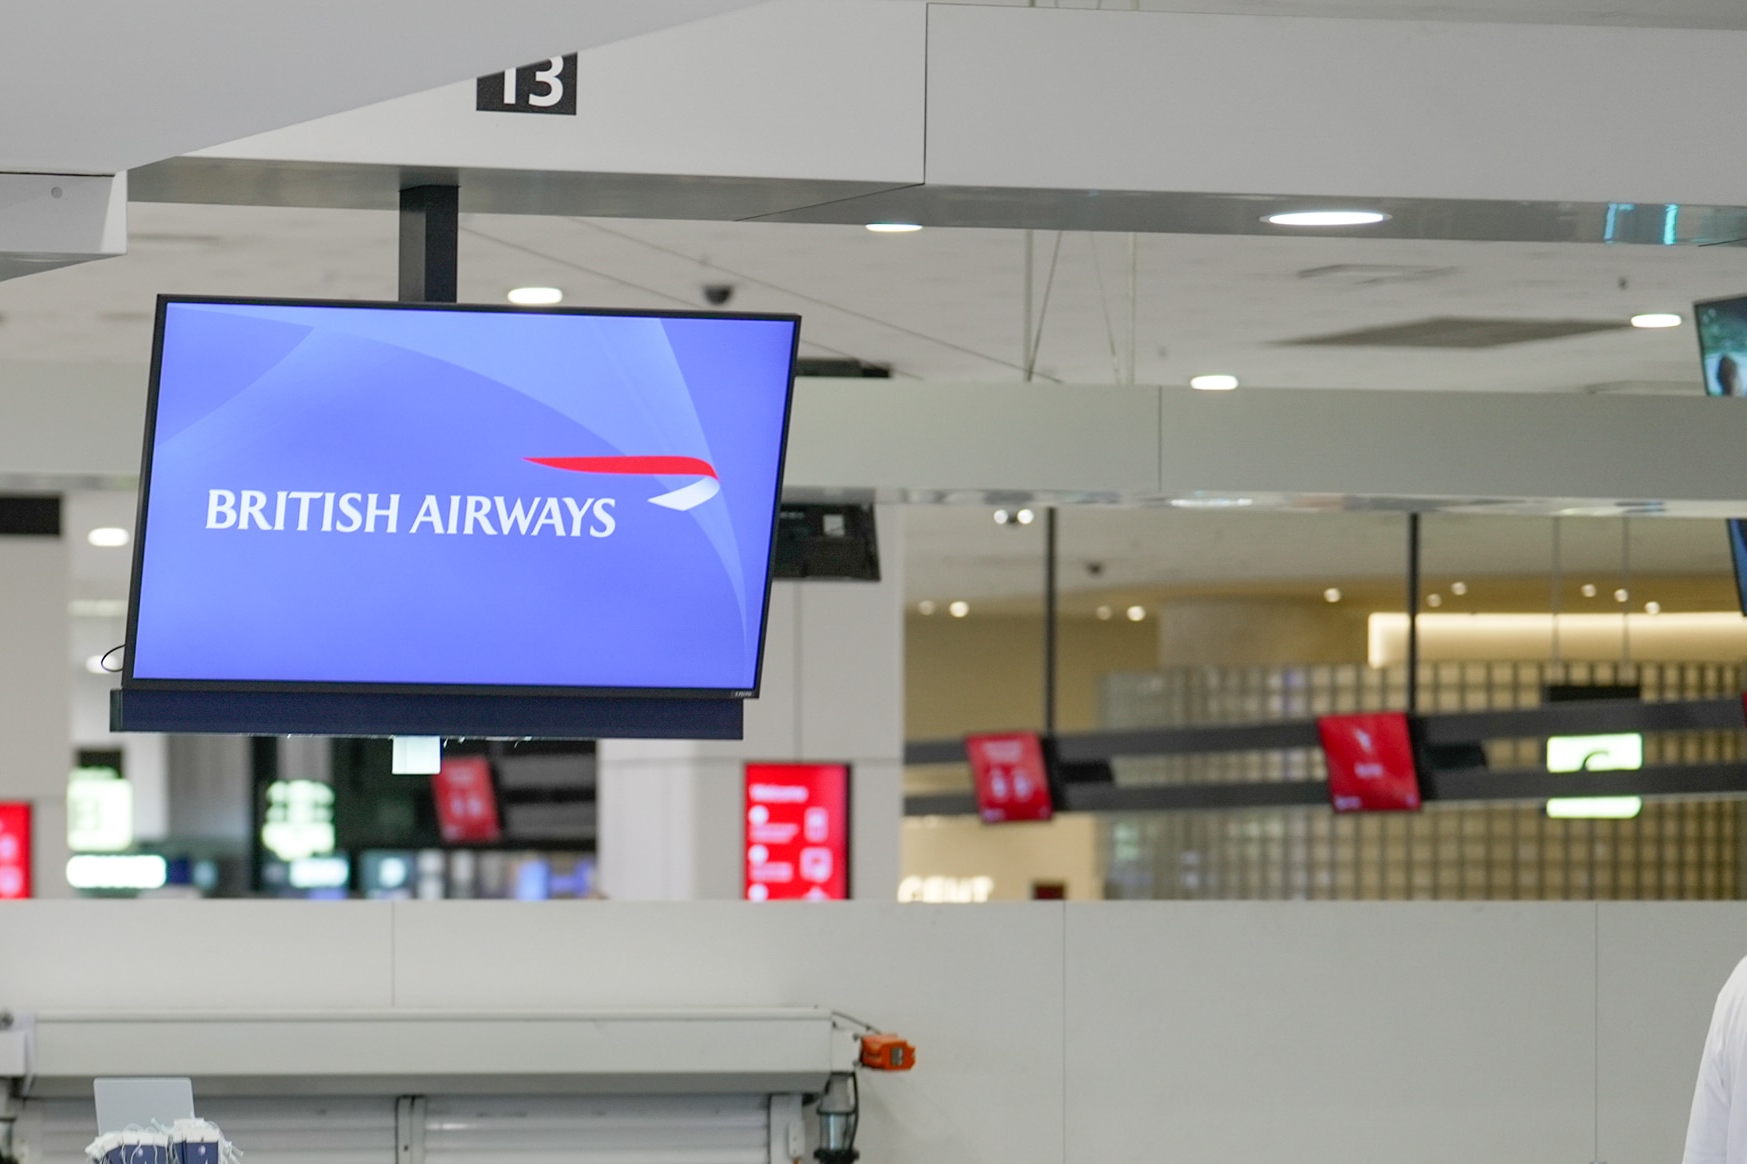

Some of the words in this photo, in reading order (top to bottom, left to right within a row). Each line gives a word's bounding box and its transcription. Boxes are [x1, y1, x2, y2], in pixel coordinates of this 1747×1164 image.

[503, 55, 564, 108] 13
[205, 488, 400, 534] BRITISH
[410, 494, 618, 538] AIRWAYS
